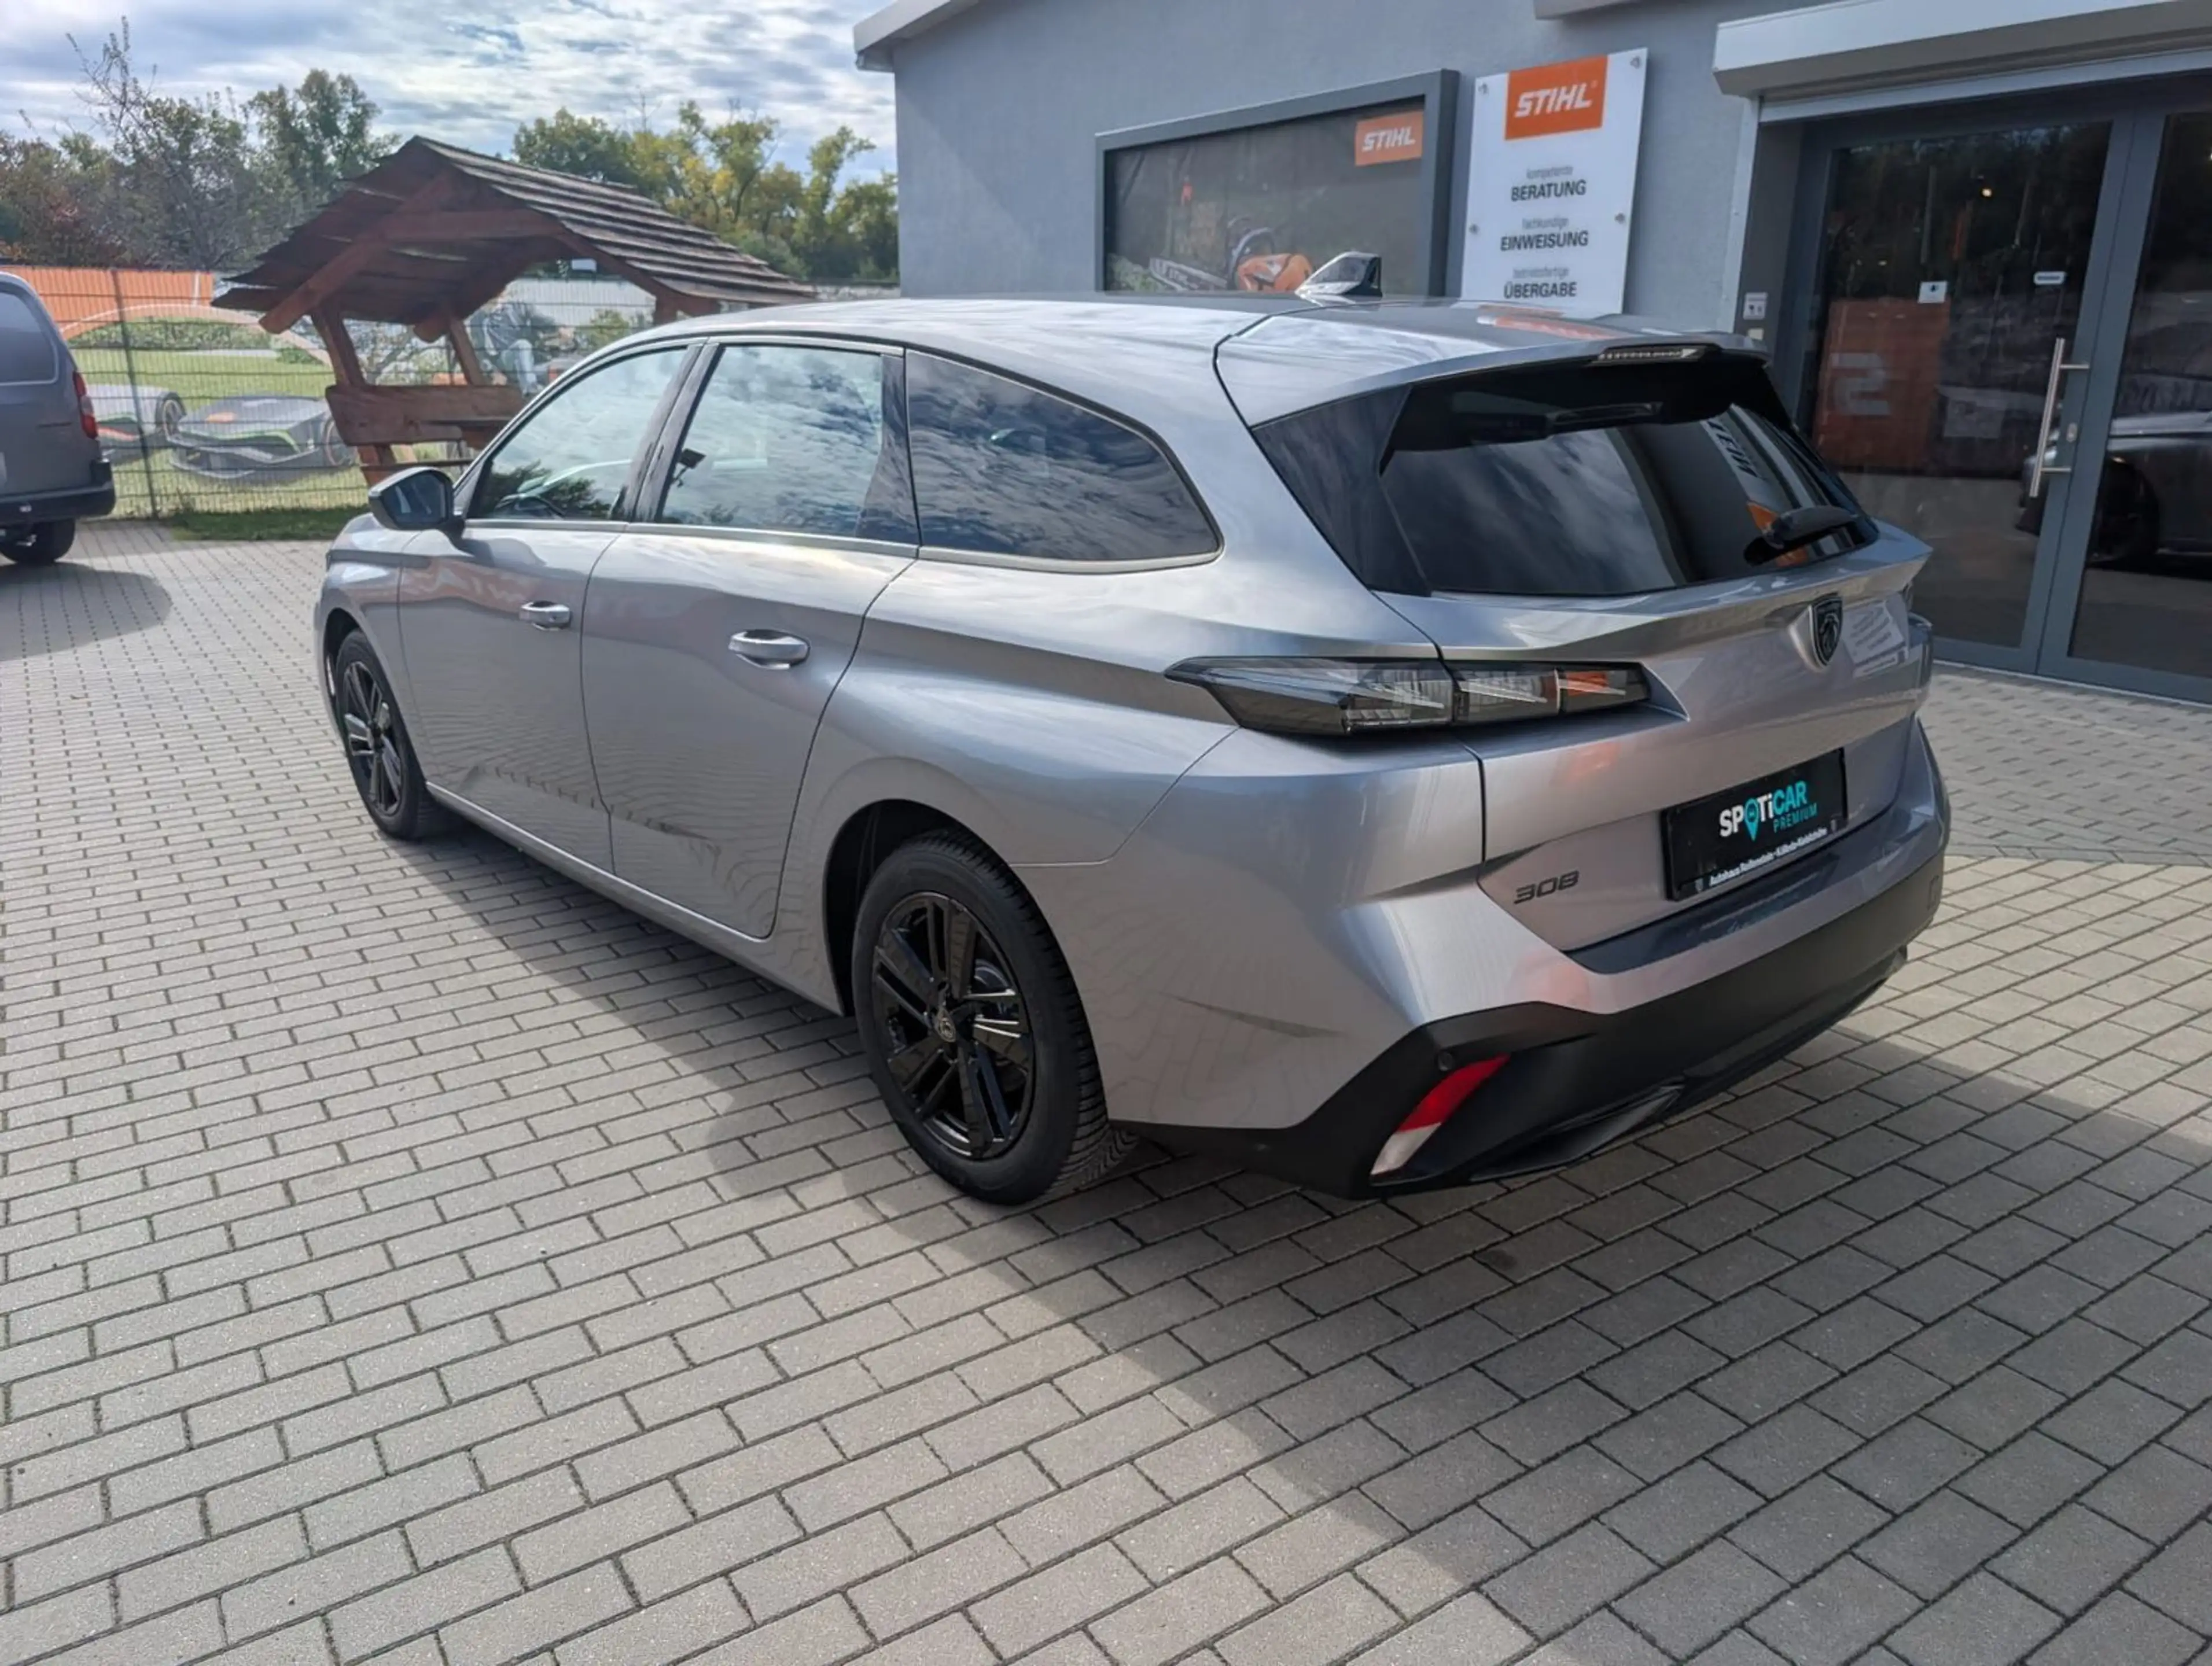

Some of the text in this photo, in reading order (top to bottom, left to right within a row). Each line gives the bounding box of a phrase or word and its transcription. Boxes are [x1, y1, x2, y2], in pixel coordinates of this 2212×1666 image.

[1514, 83, 1593, 117] STIHL
[1361, 126, 1416, 152] STIHL
[1511, 179, 1587, 201] BERATUNG
[1500, 230, 1589, 251] EINWEISUNG
[1503, 281, 1577, 299] ÜBERGABE
[1773, 803, 1818, 833] PREMIUM
[1514, 870, 1580, 905] 308
